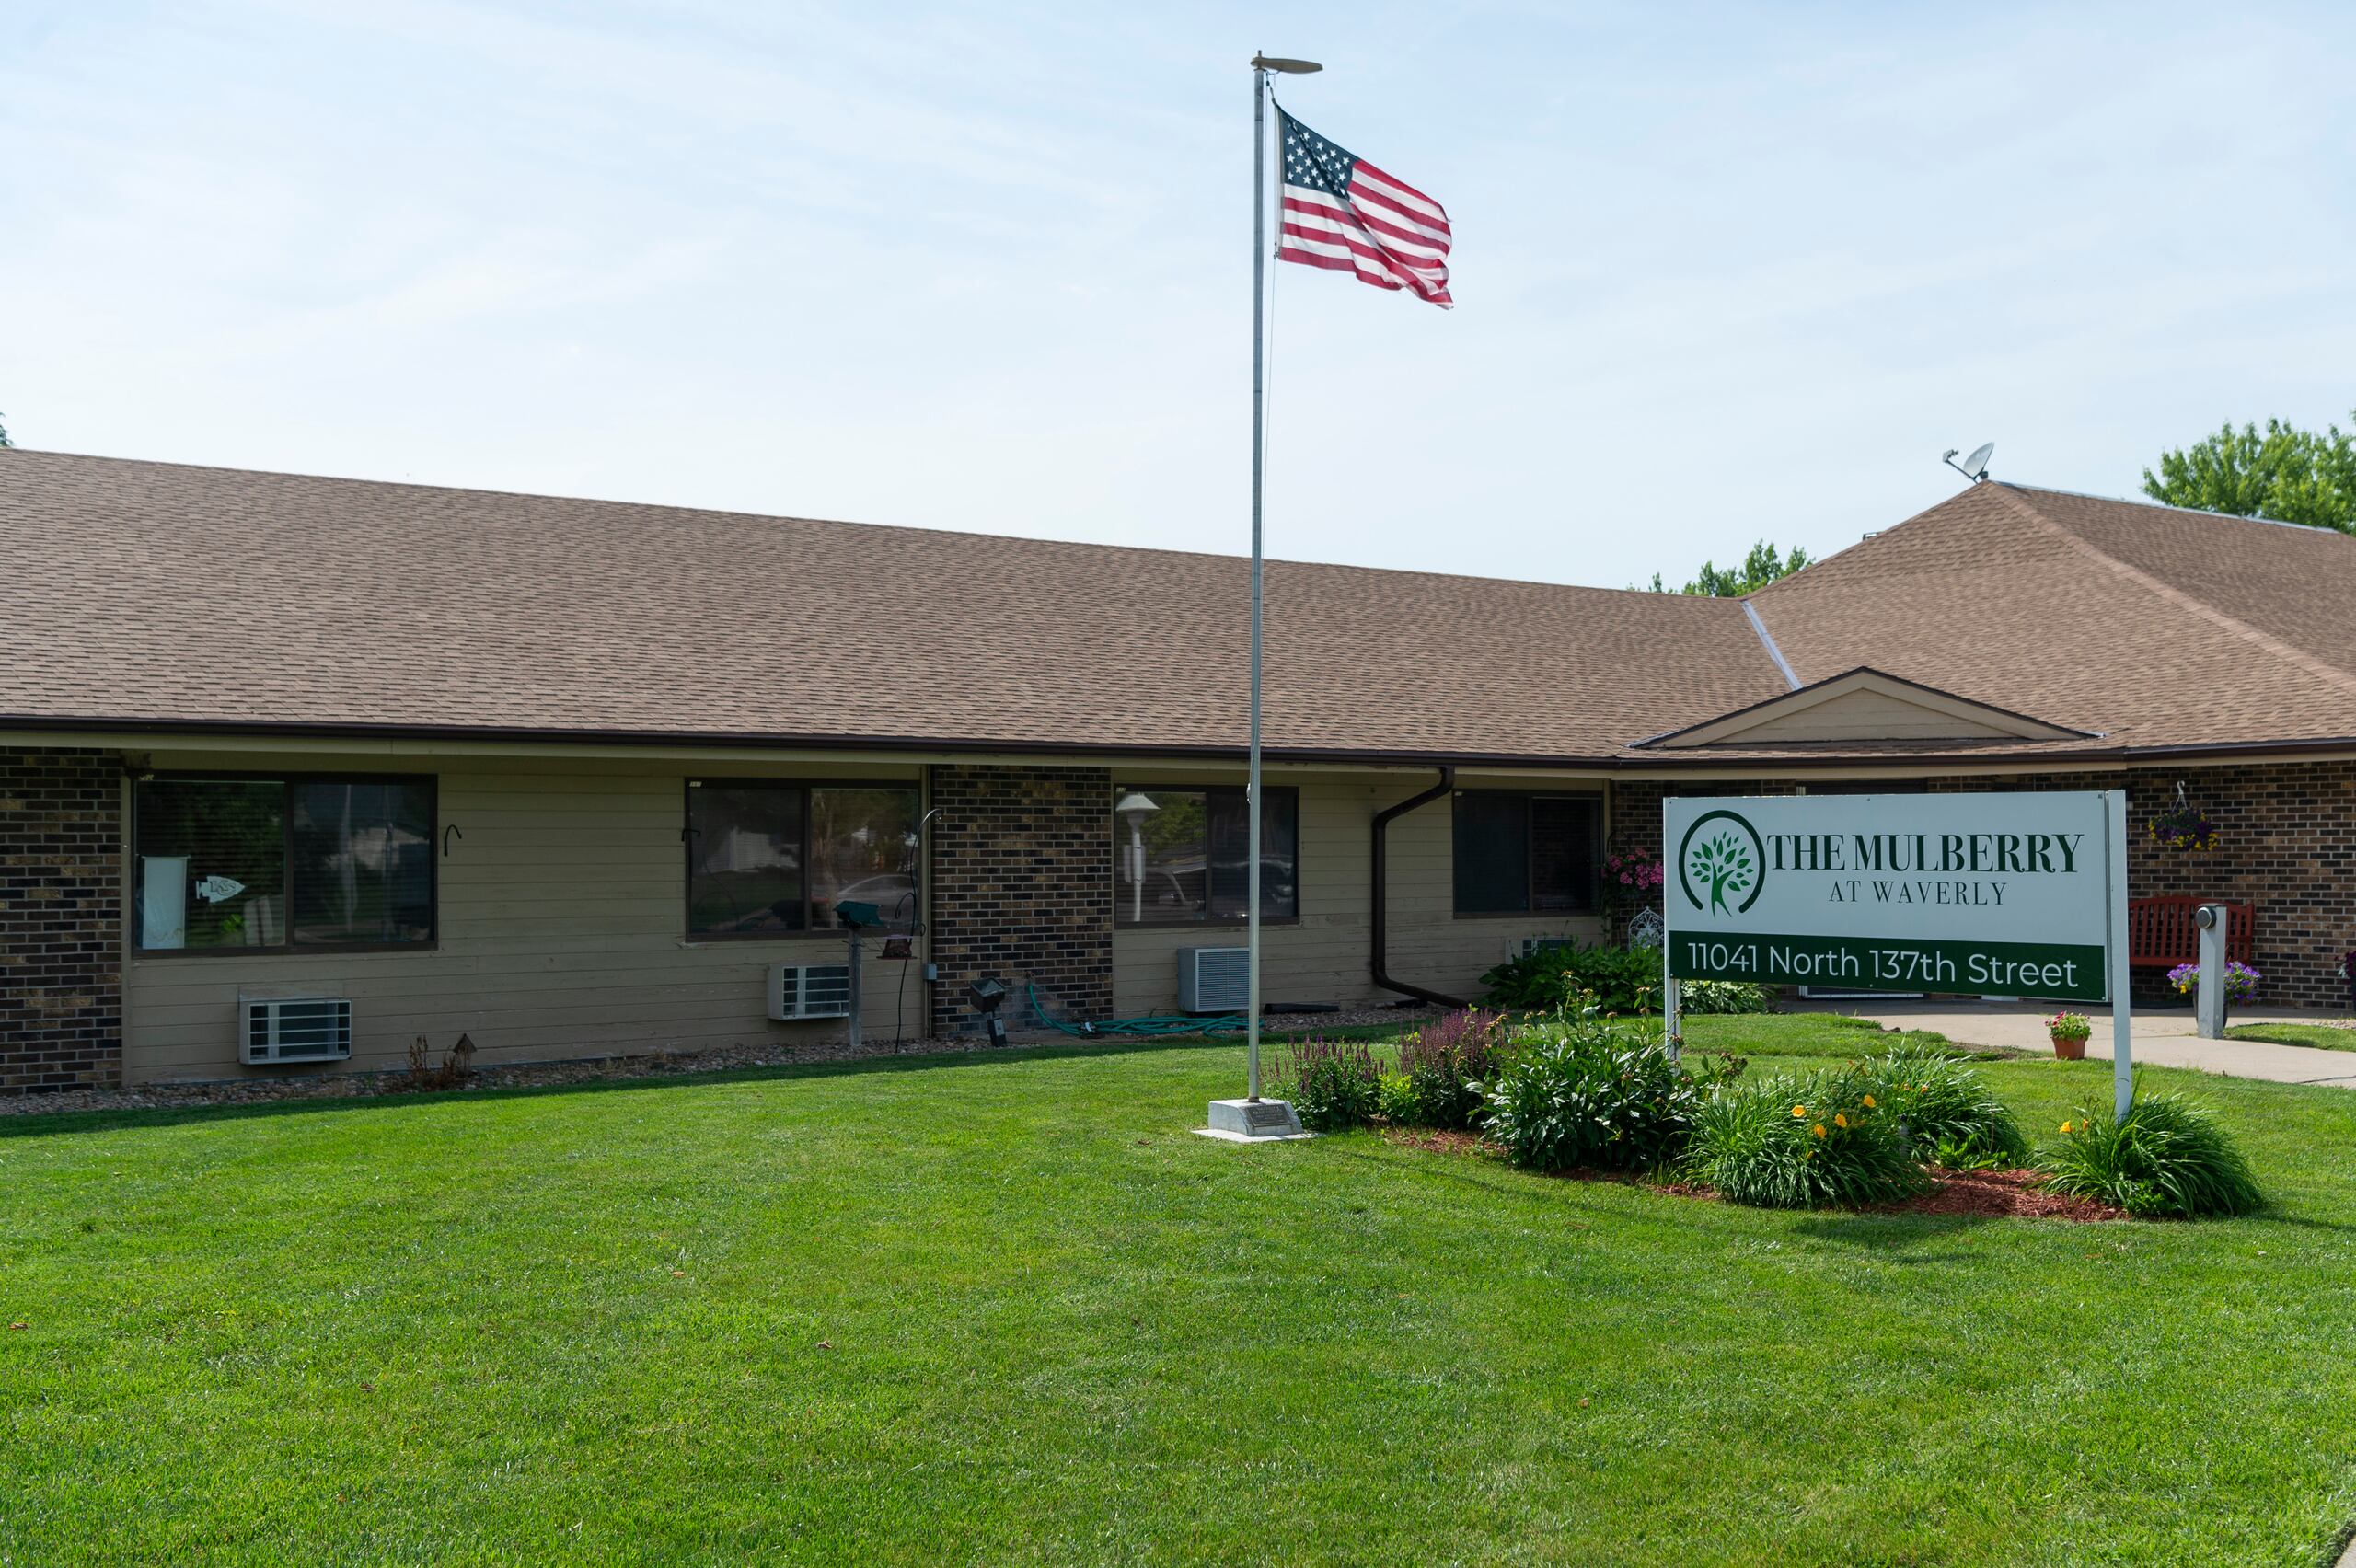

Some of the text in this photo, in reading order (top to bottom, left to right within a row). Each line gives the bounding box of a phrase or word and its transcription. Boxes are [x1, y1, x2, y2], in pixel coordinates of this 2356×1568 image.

[1766, 834, 2085, 874] THE MULBERRY
[1829, 880, 2006, 905] AT WAVERLY
[1687, 942, 2079, 988] 11041 North 137th Street
